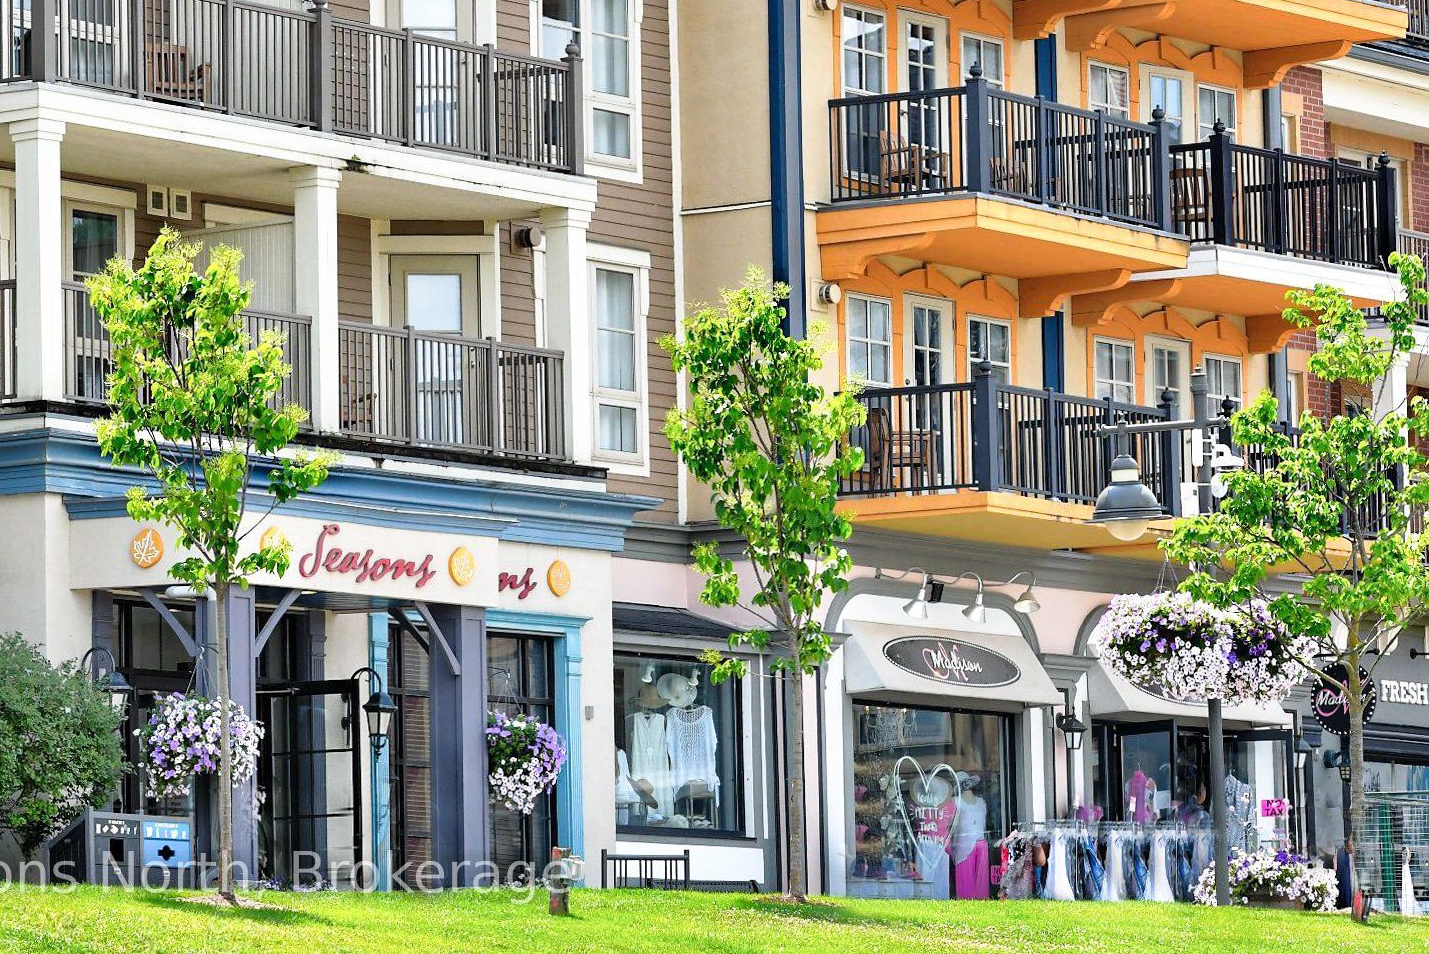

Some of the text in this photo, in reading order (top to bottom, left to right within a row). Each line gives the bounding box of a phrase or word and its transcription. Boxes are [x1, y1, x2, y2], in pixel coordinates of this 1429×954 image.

[299, 524, 437, 588] Seasons
[922, 642, 983, 681] Madison
[1380, 679, 1429, 706] FRESH
[1265, 808, 1283, 817] TAX
